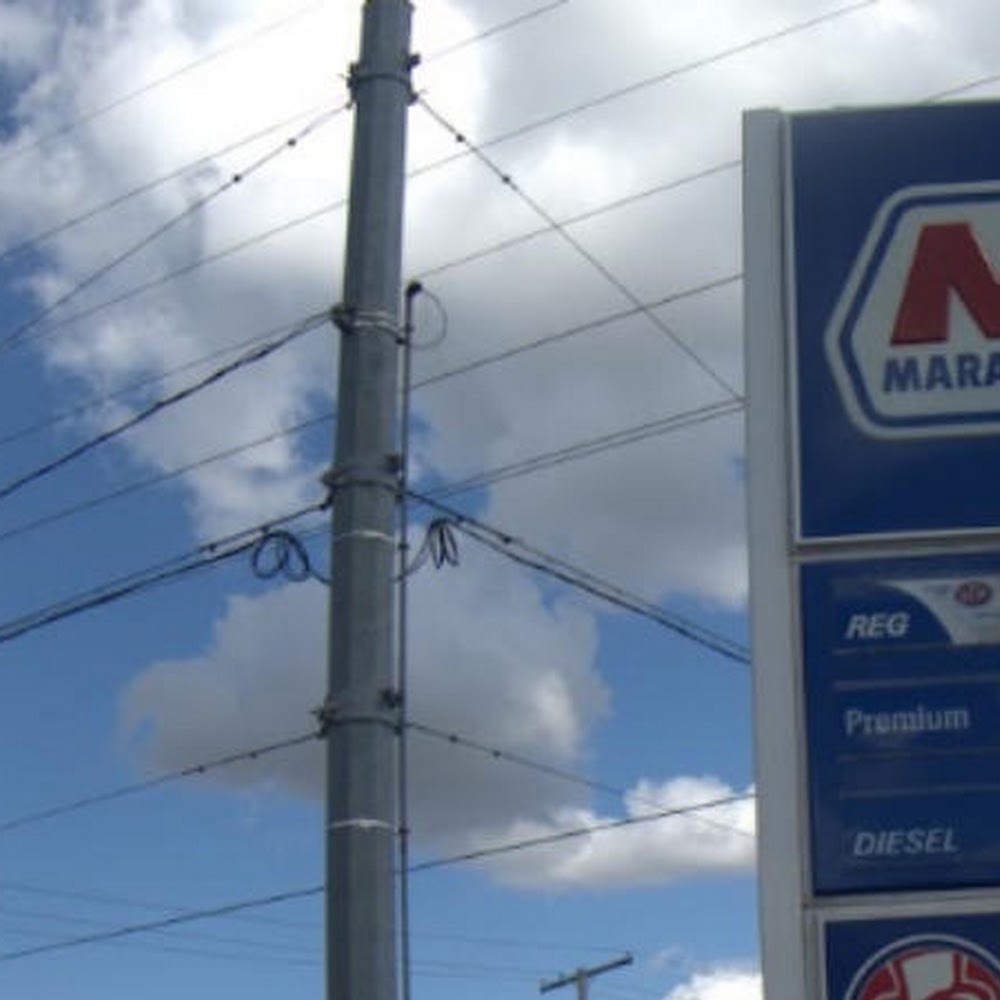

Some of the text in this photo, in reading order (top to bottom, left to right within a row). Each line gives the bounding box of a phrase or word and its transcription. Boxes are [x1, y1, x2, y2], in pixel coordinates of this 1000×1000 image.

[846, 612, 910, 639] REG
[846, 706, 970, 736] Premium
[854, 828, 959, 857] DIESEL
